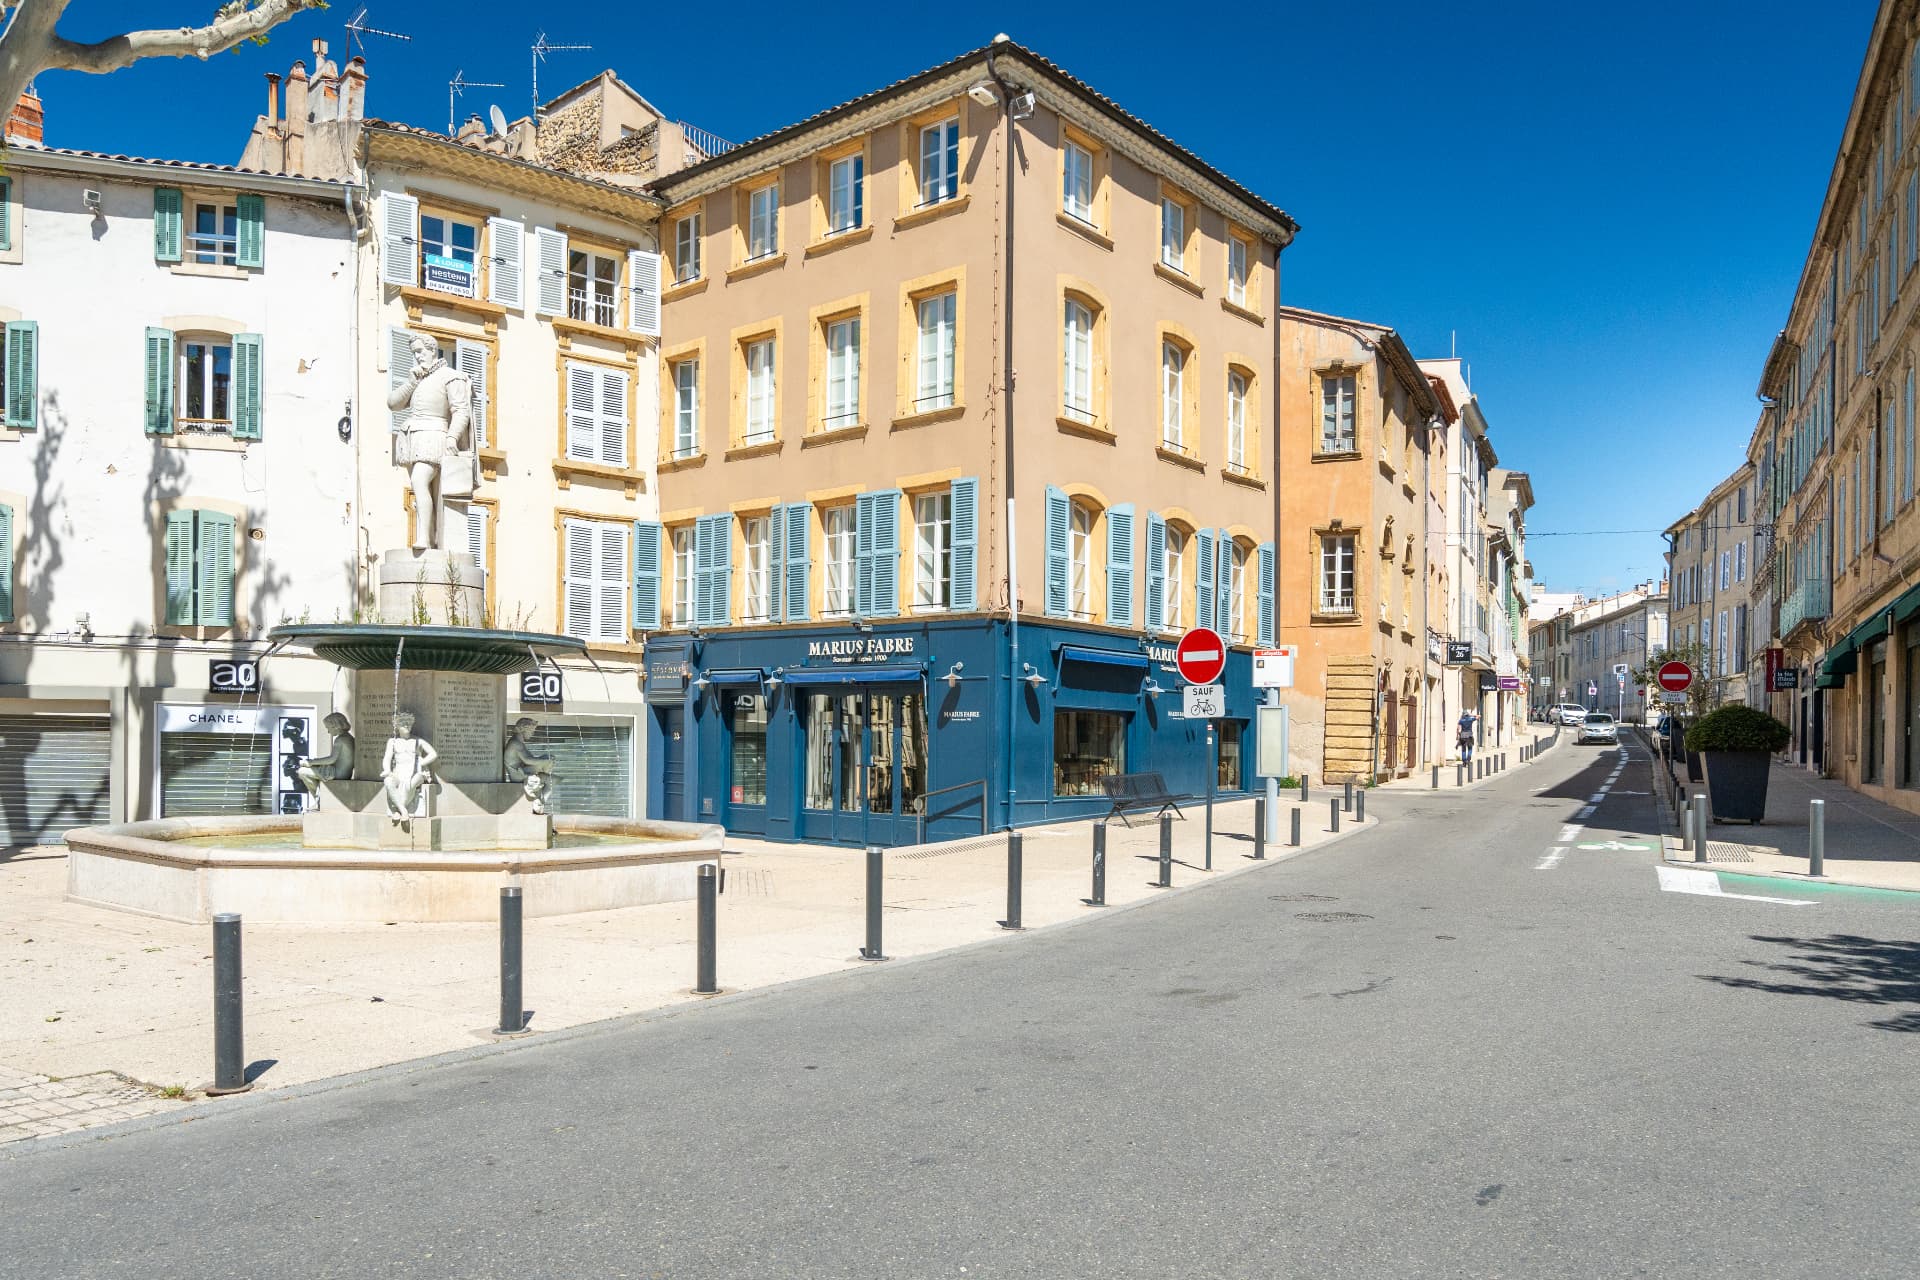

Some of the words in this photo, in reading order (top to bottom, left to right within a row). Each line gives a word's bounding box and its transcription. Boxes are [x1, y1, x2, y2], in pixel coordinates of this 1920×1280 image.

[441, 259, 464, 268] LOUER
[808, 639, 863, 656] MARIUS
[867, 637, 914, 653] FABRE
[874, 654, 888, 662] 1900
[1144, 645, 1177, 662] MARIU
[1192, 687, 1214, 696] SAUF
[188, 714, 243, 723] CHANEL
